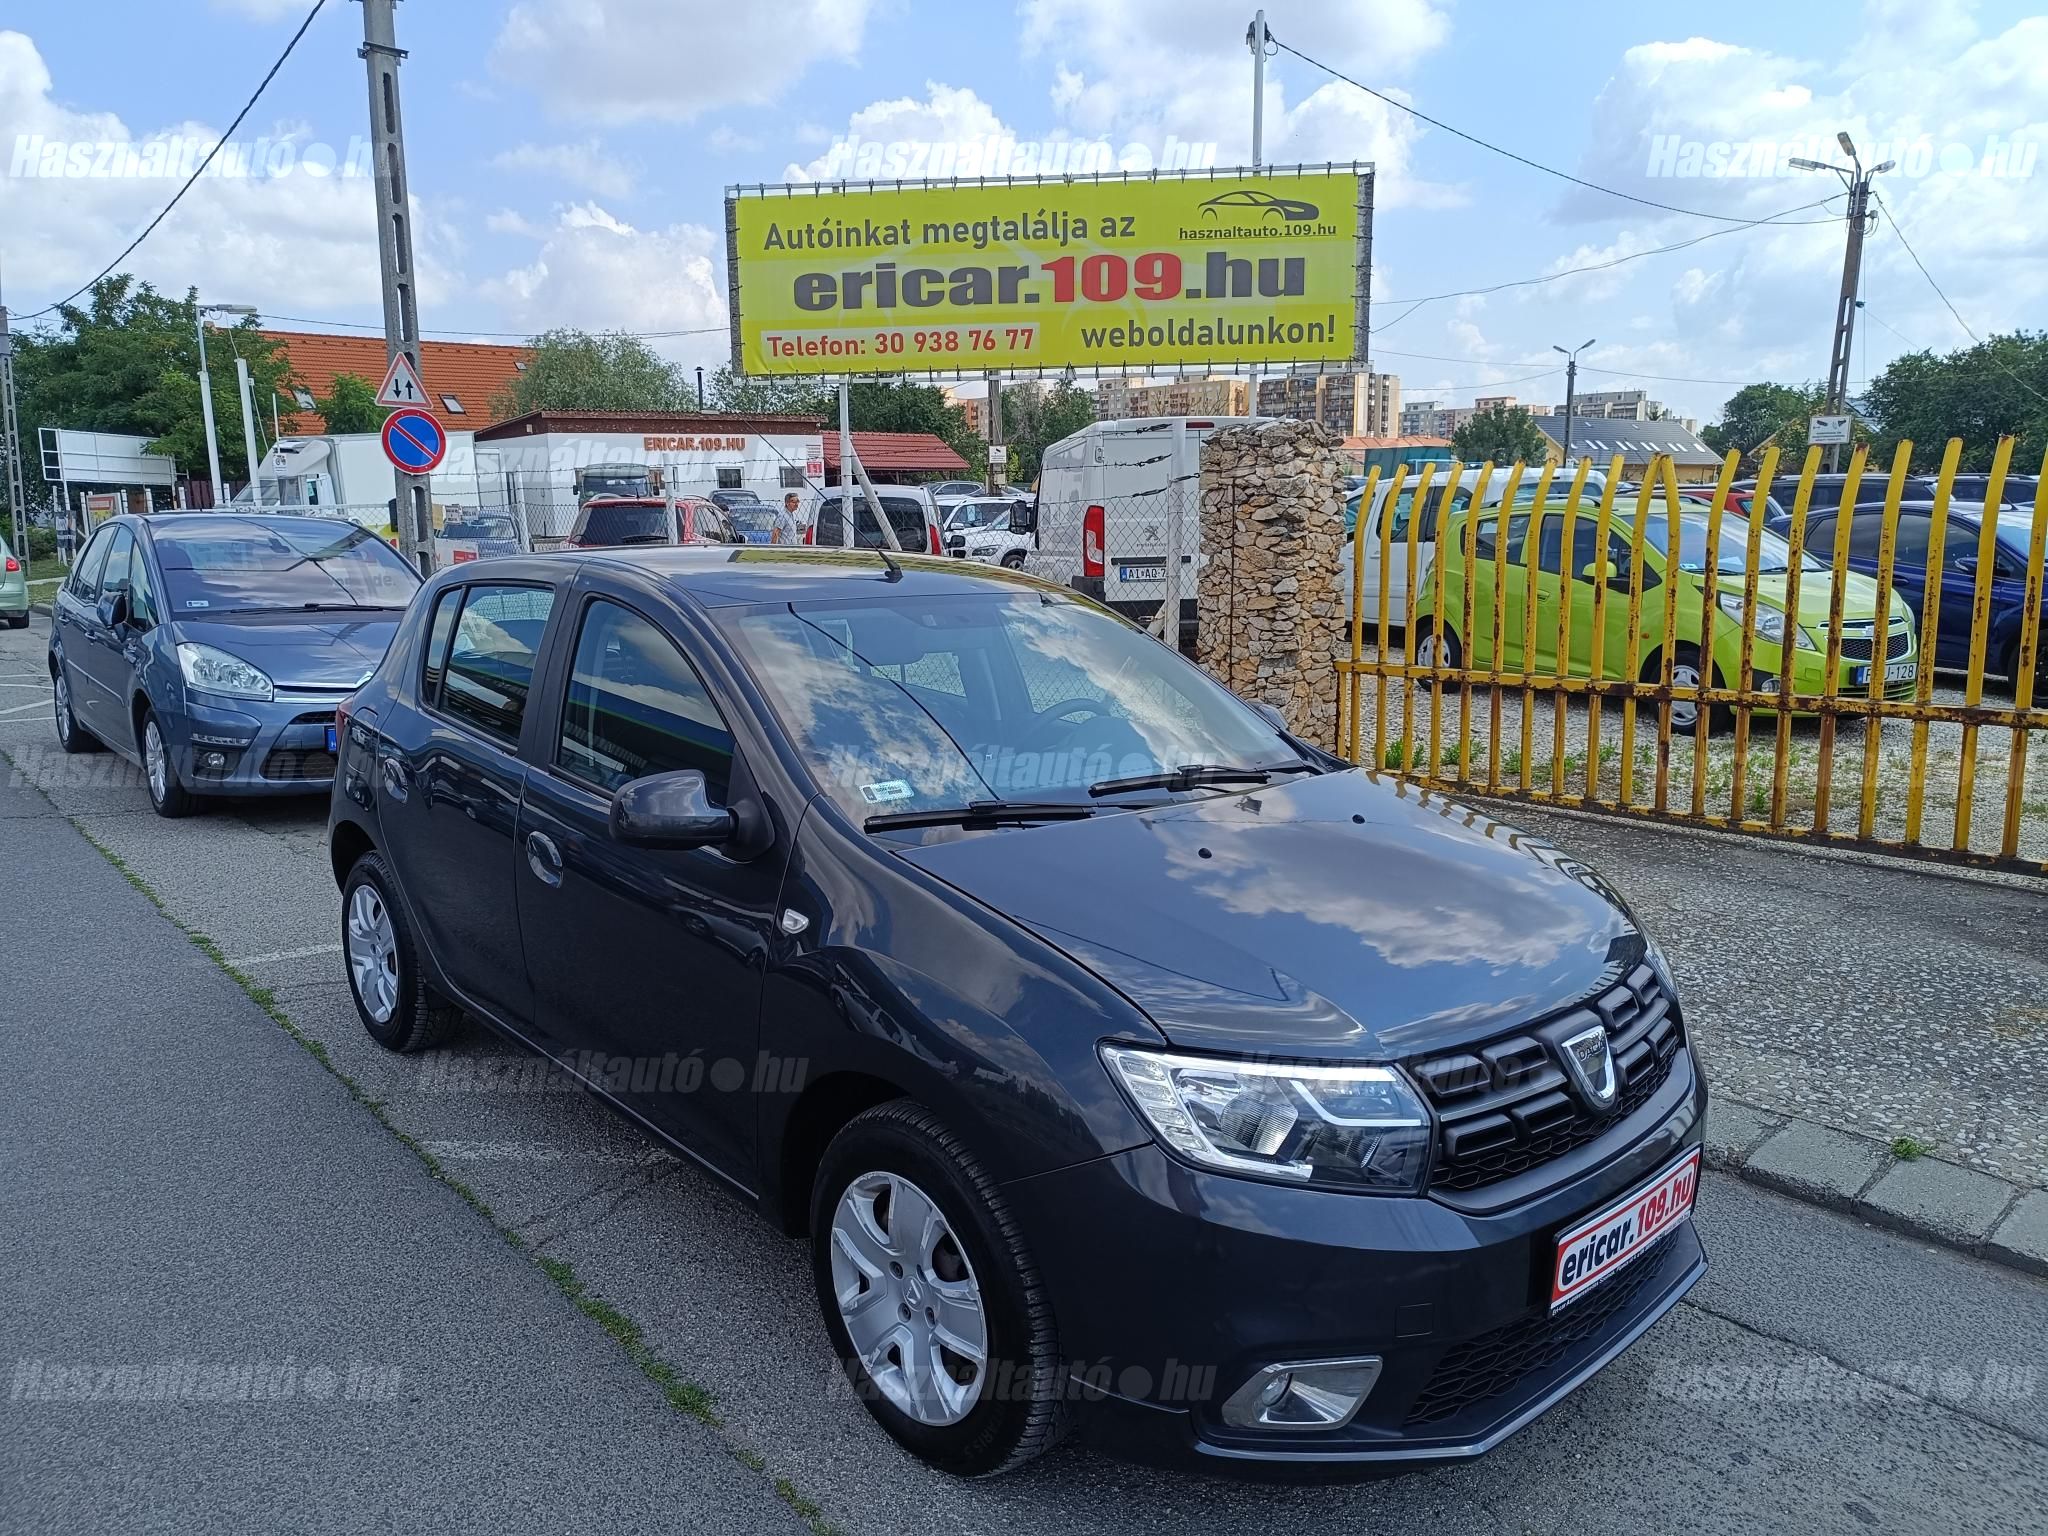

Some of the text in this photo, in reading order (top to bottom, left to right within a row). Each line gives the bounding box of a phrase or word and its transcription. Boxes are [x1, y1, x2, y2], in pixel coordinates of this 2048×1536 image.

[764, 208, 1135, 250] Autóinkat megtalálja az
[1179, 224, 1337, 239] hasznaltauto.109.hu
[794, 252, 1305, 311] ericar.109.hu
[767, 328, 1034, 357] Telefon: 30 938 76 77
[1081, 315, 1335, 349] weboldalunkon!
[644, 437, 745, 451] ERICAR.109.HU
[1562, 1171, 1692, 1286] ericar.109.hu
